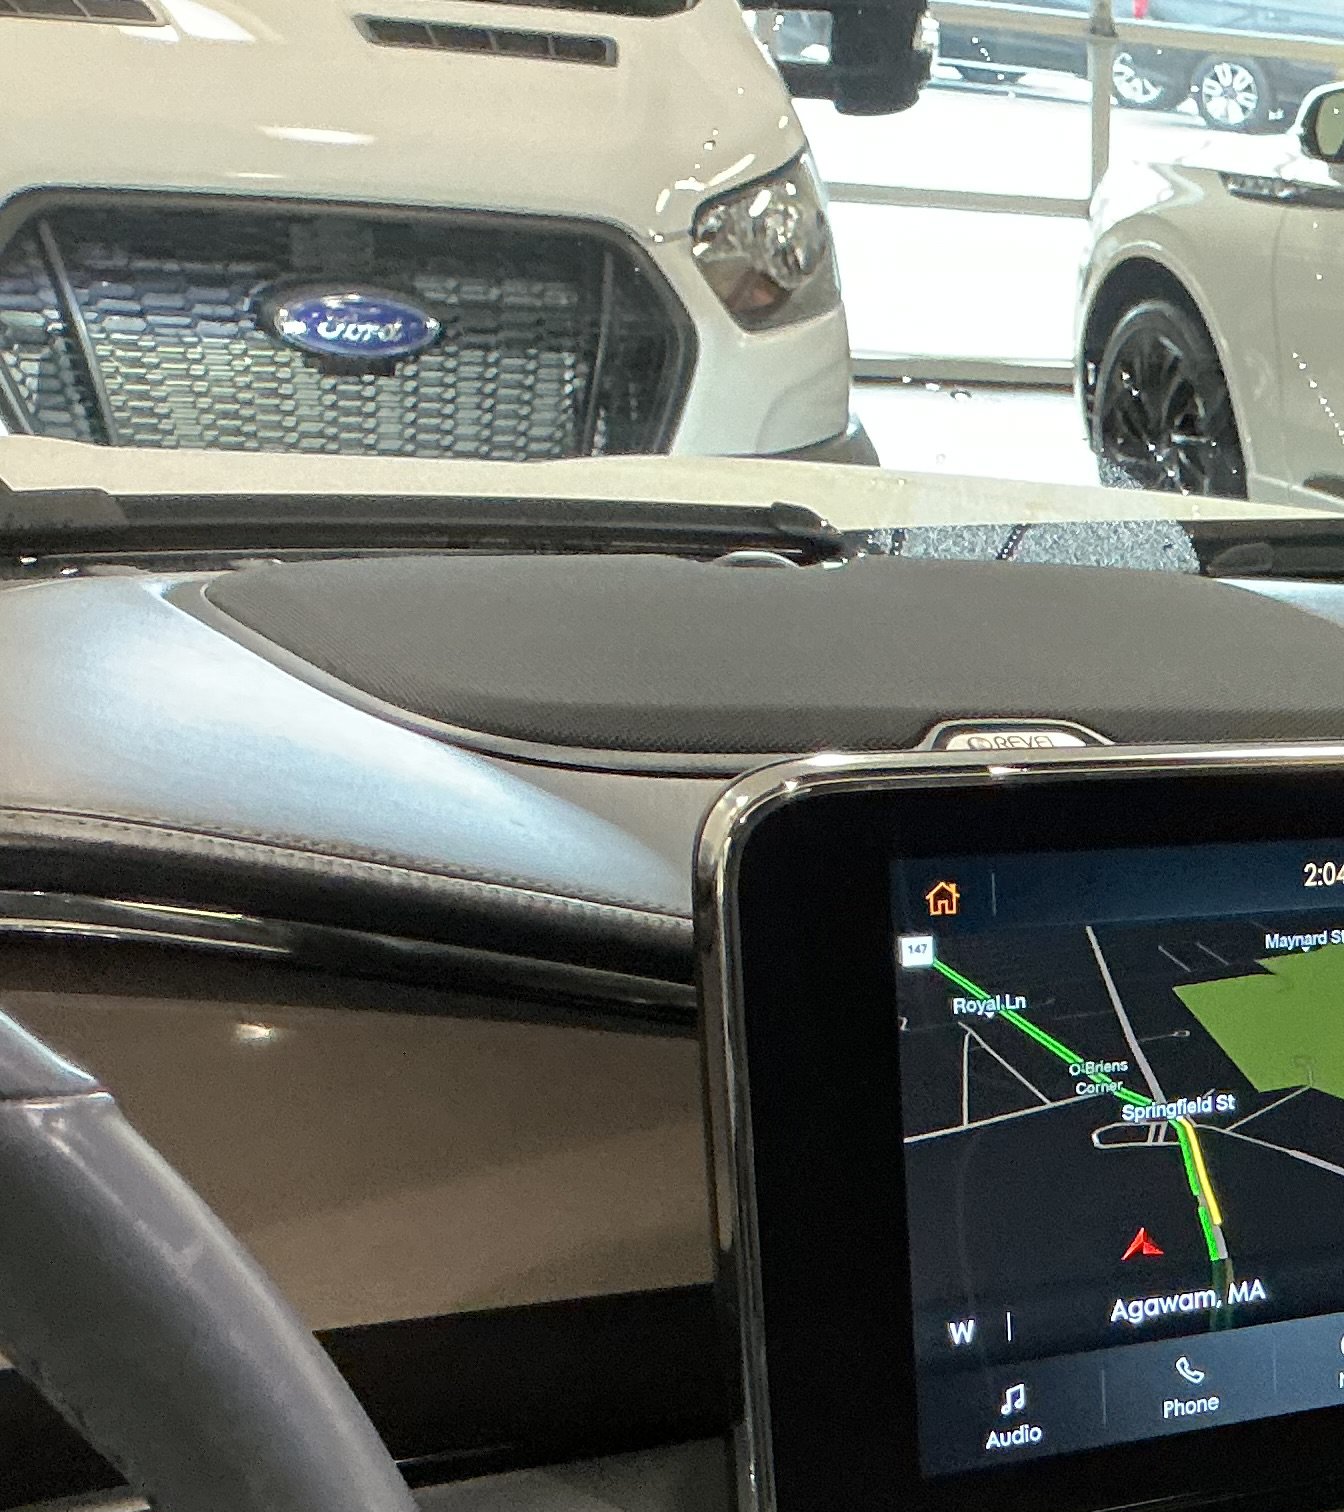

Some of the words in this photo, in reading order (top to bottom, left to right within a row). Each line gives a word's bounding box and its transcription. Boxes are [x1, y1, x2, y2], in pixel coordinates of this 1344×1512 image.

[907, 943, 928, 955] 147
[1264, 931, 1327, 950] Maynard
[952, 996, 998, 1017] Royal
[1002, 994, 1027, 1012] Ln
[1075, 1080, 1124, 1095] Corner
[1121, 1096, 1213, 1122] Springfield
[1216, 1094, 1236, 1111] St
[1110, 1284, 1222, 1325] Agawam,
[1226, 1278, 1266, 1306] MA
[948, 1319, 975, 1345] W
[1163, 1395, 1220, 1419] Phone
[985, 1424, 1042, 1450] Audio
